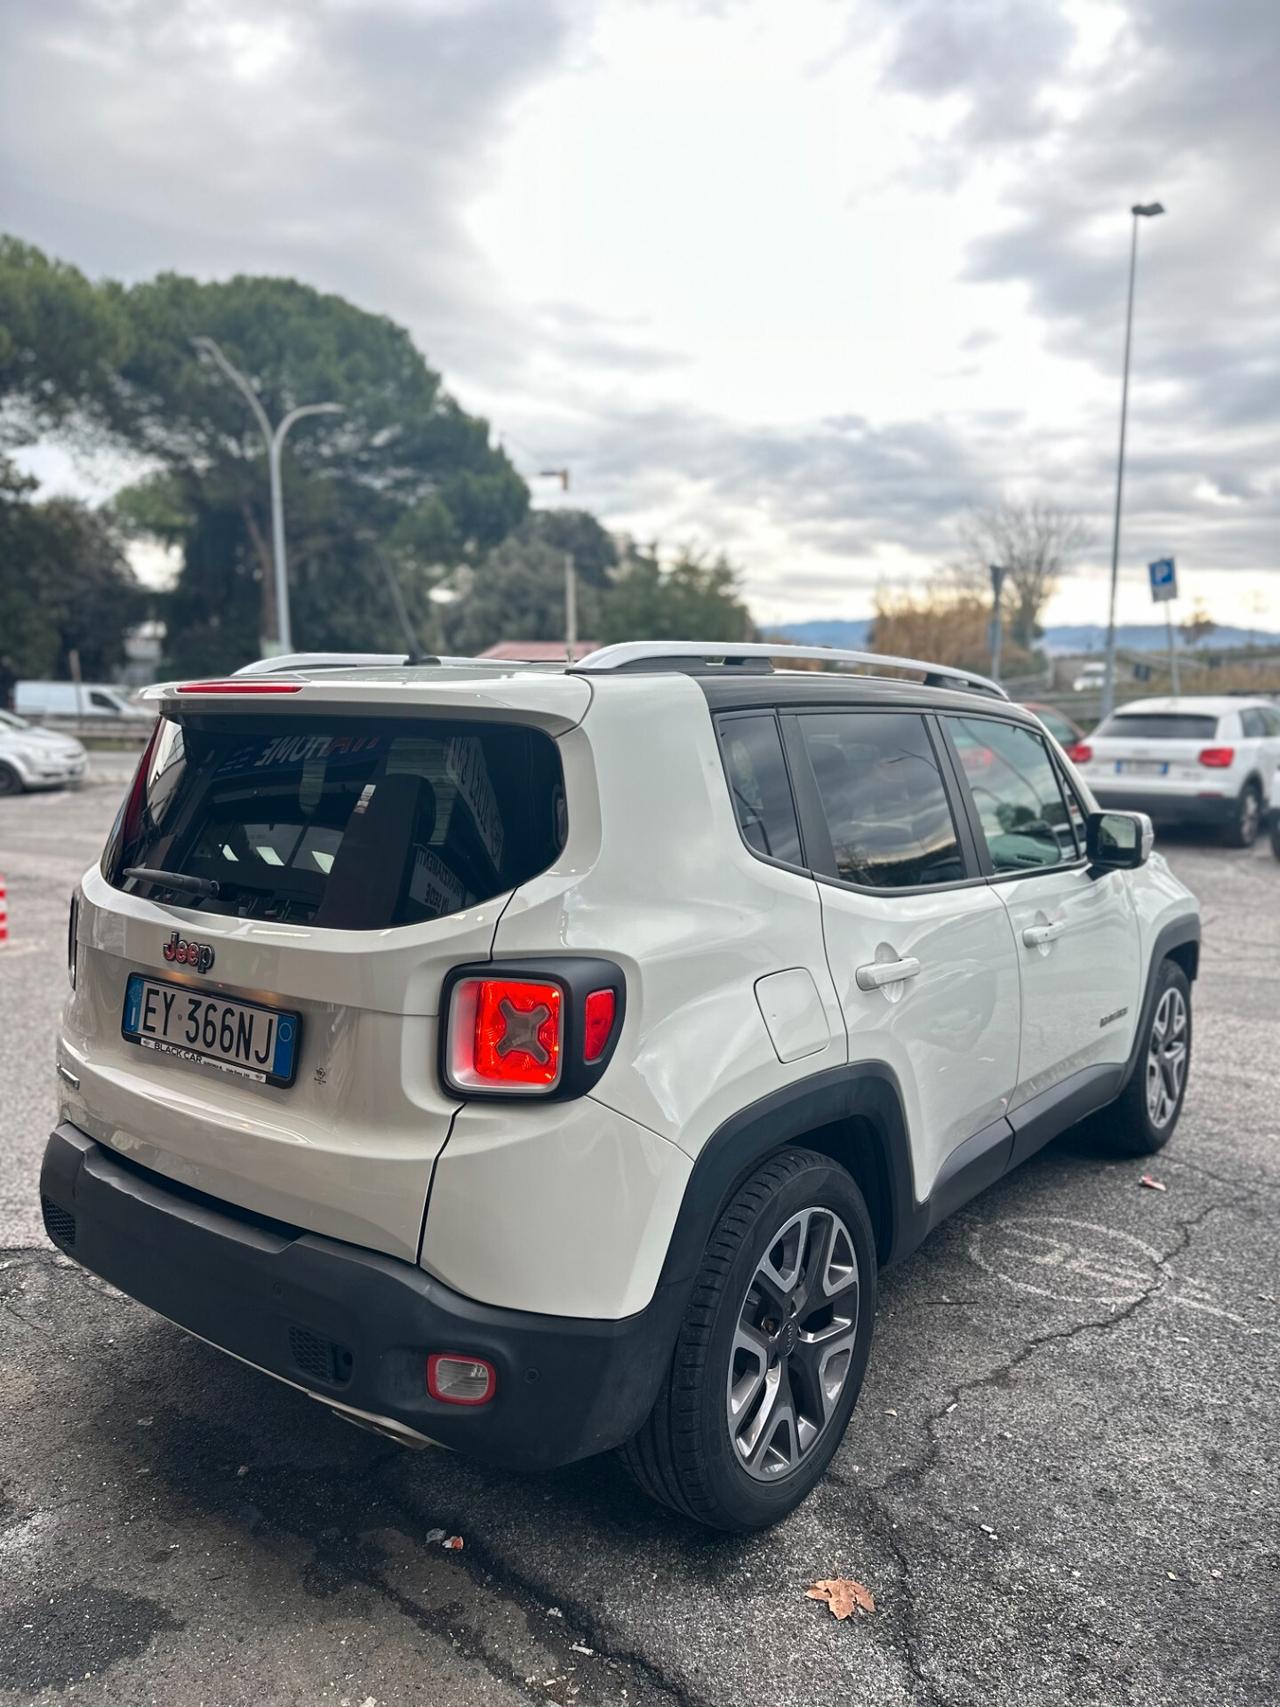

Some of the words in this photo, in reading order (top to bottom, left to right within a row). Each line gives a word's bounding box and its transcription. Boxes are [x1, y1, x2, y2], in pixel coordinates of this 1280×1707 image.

[163, 932, 214, 974] Jeep
[154, 1042, 182, 1058] BLACK
[184, 1052, 203, 1064] CAR
